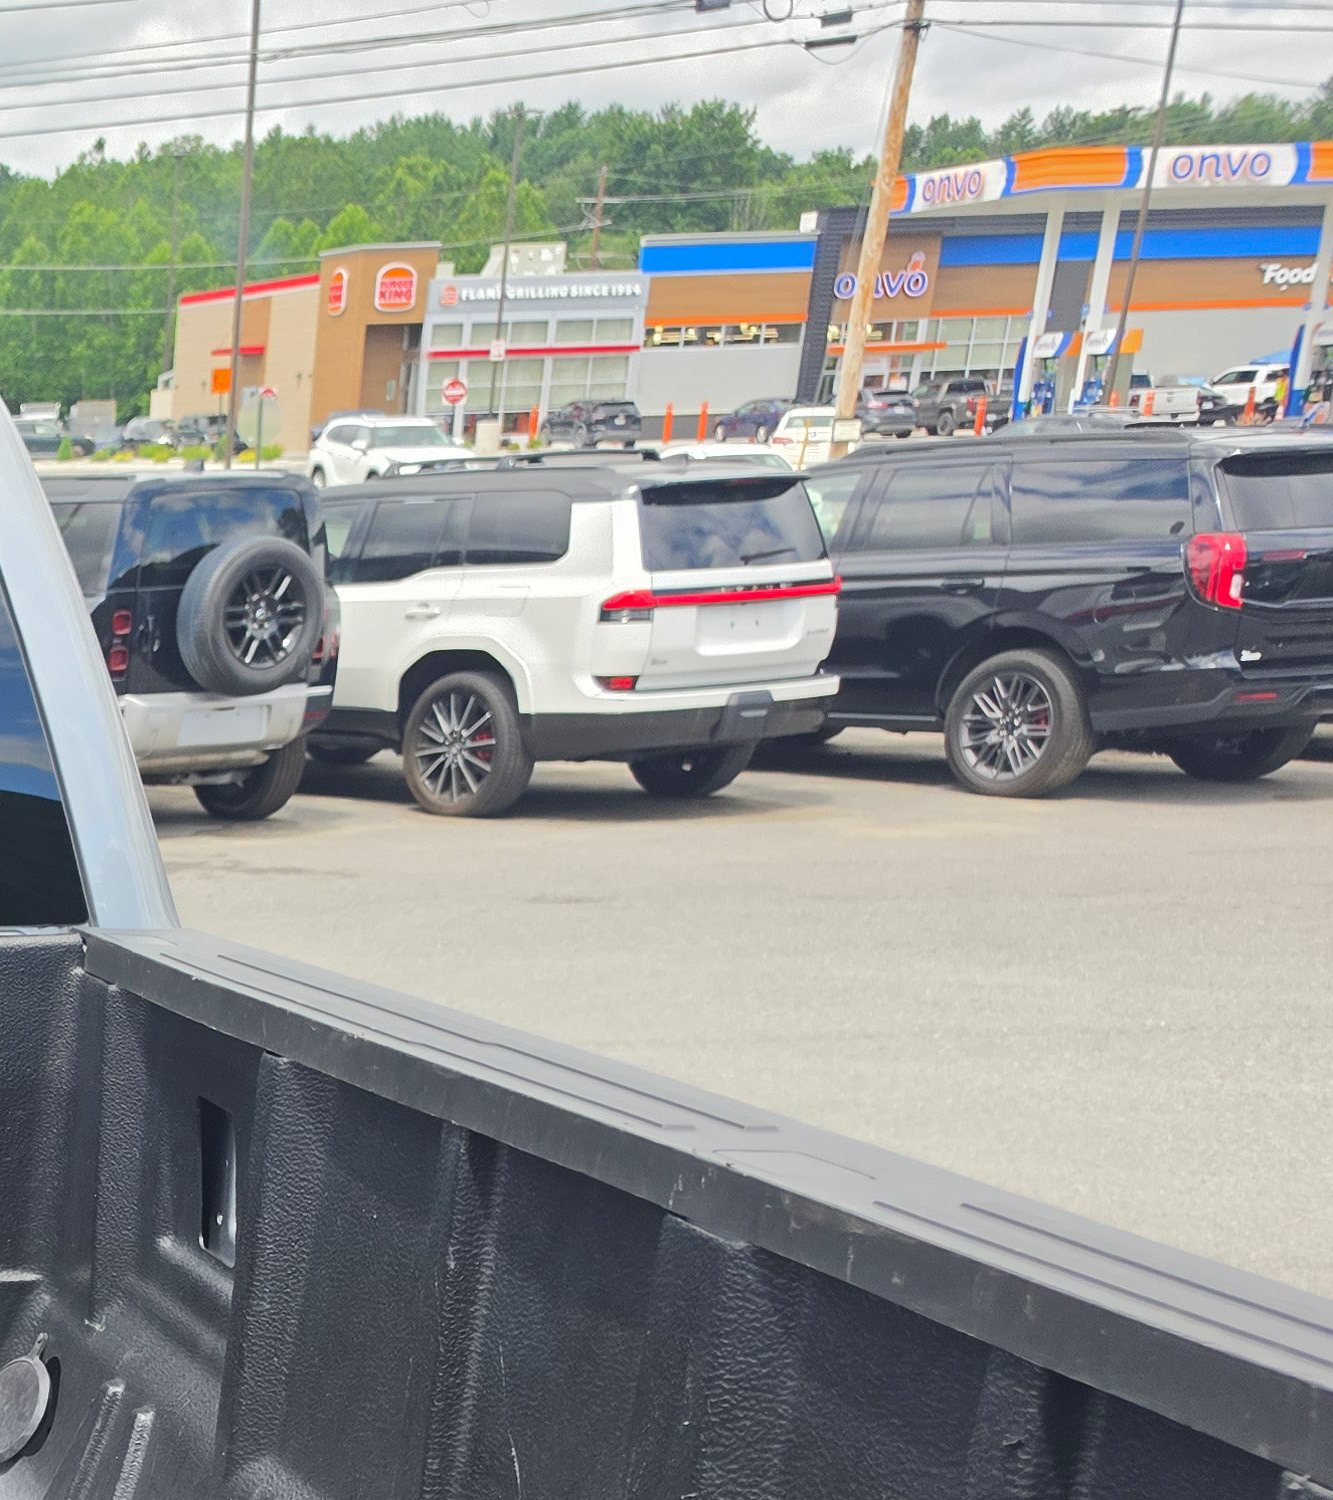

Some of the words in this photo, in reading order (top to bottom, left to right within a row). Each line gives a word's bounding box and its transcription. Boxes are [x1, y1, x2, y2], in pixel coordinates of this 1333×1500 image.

[1171, 152, 1272, 180] onvo
[921, 170, 982, 202] onvo
[1259, 262, 1318, 285] Food
[569, 284, 608, 298] SINCE
